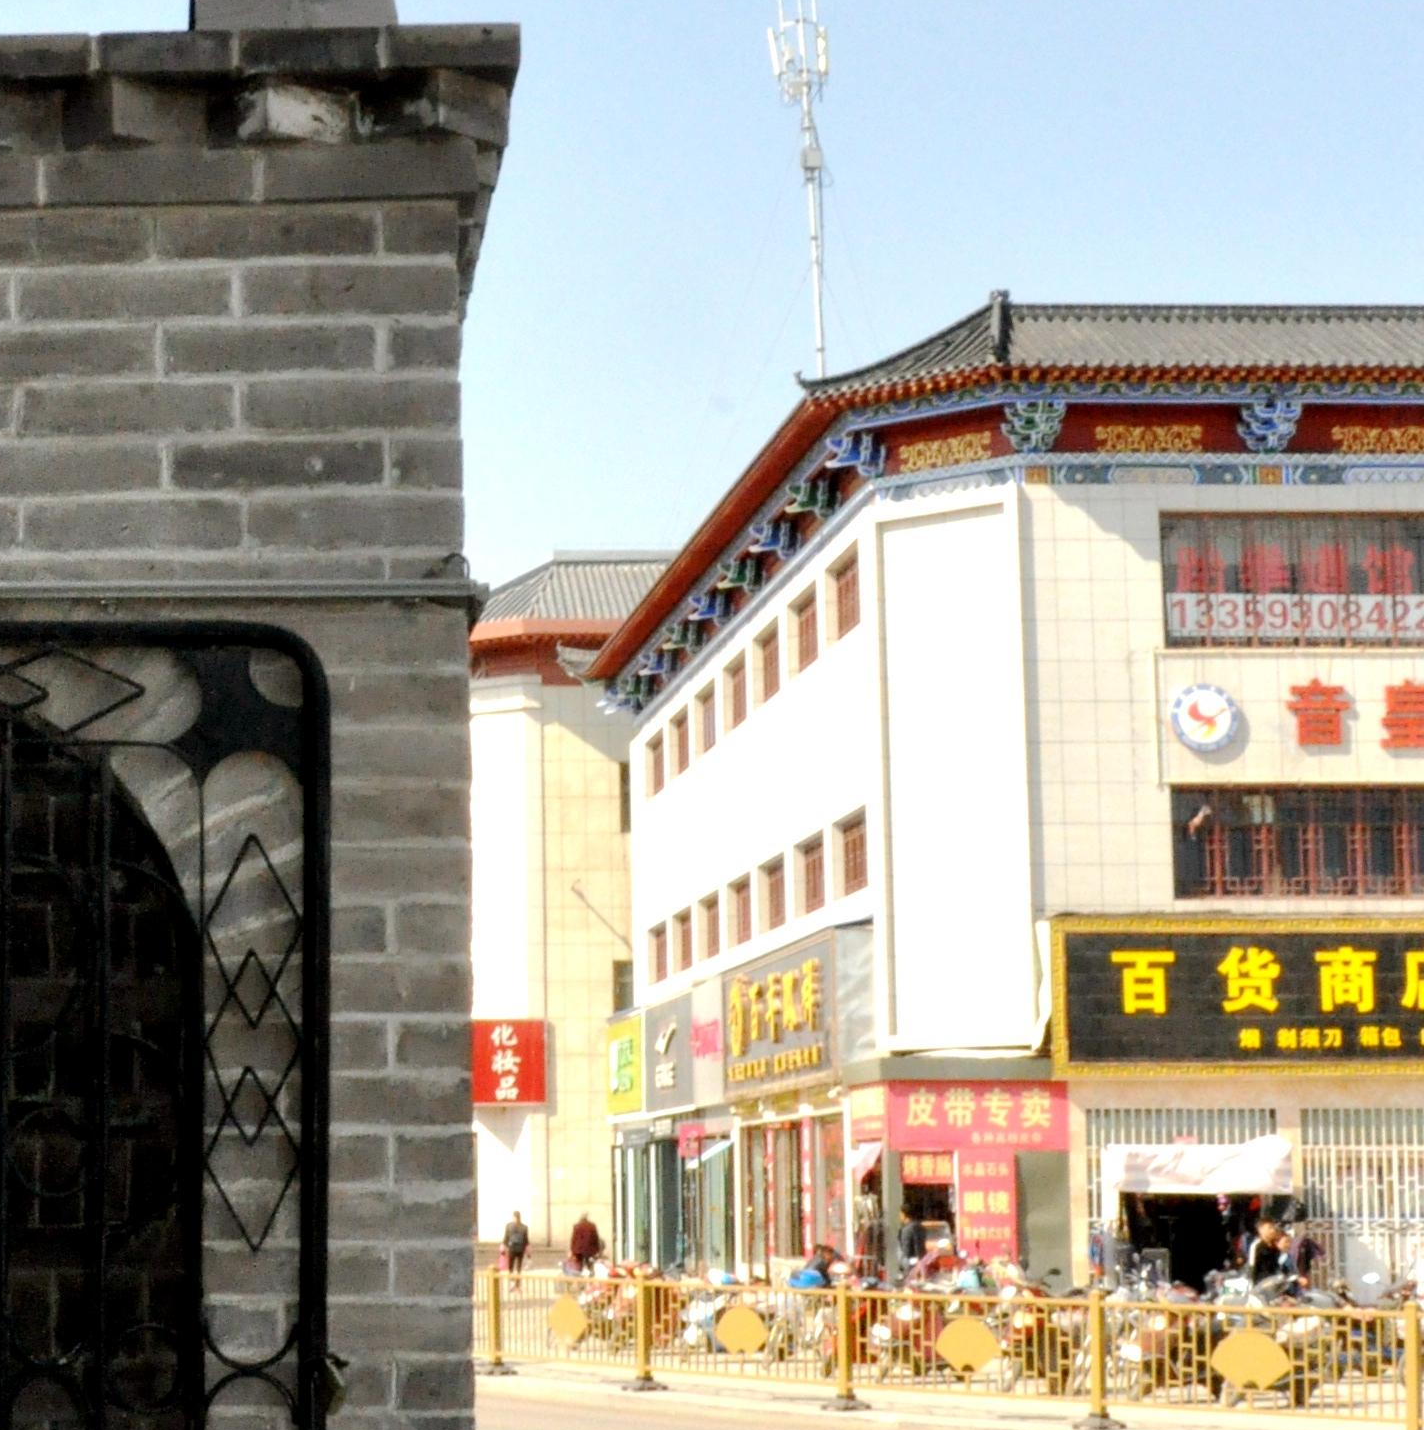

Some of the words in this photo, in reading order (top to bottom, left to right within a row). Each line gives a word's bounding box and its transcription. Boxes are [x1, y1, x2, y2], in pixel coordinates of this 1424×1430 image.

[1359, 1025, 1403, 1048] 箱包
[490, 1023, 522, 1100] 化妆品
[905, 1087, 1052, 1129] 皮带专卖
[963, 1190, 1010, 1214] 眼镜
